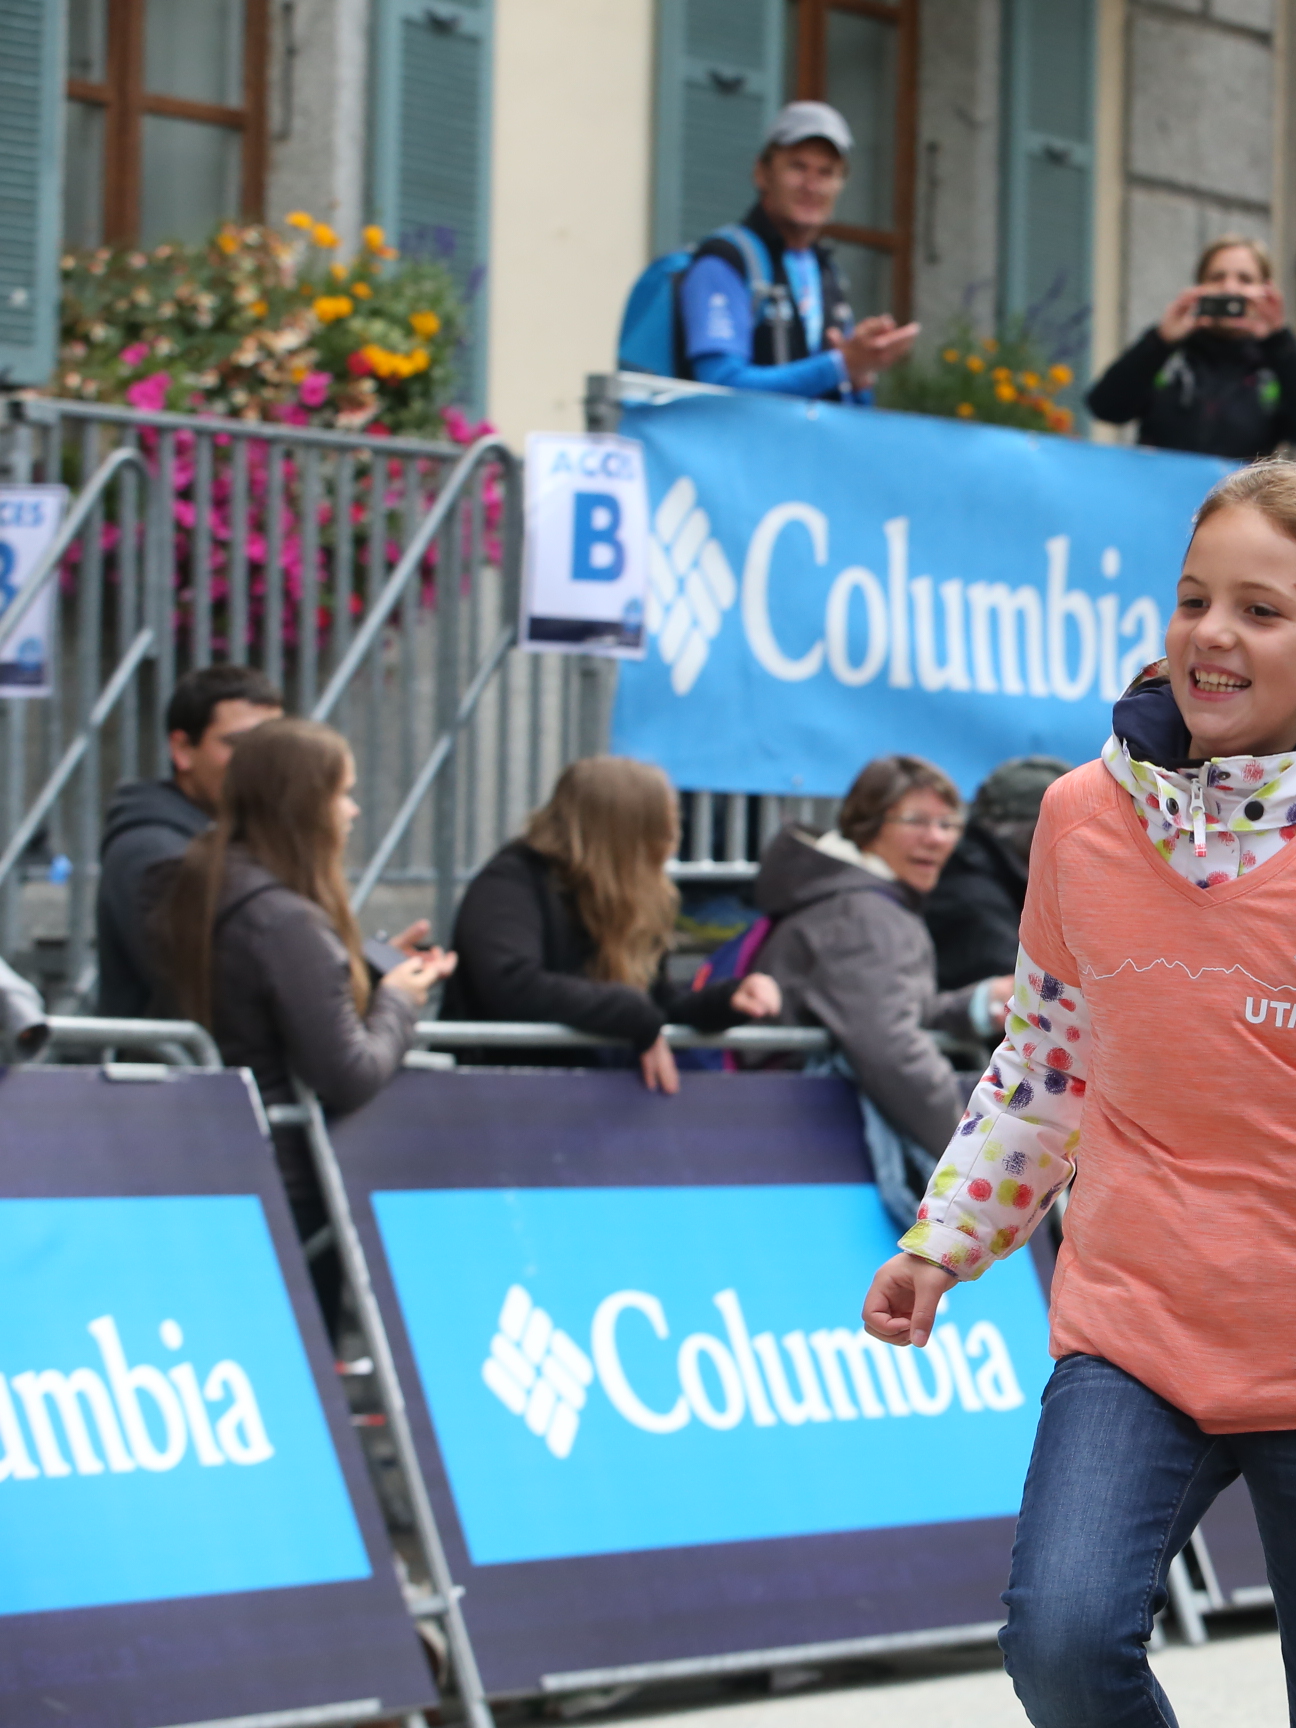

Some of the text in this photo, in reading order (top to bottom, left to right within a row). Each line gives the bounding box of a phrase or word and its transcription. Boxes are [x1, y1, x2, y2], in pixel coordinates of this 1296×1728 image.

[571, 490, 625, 583] B
[741, 500, 1166, 700] Columbia
[591, 1287, 1026, 1435] Columbia
